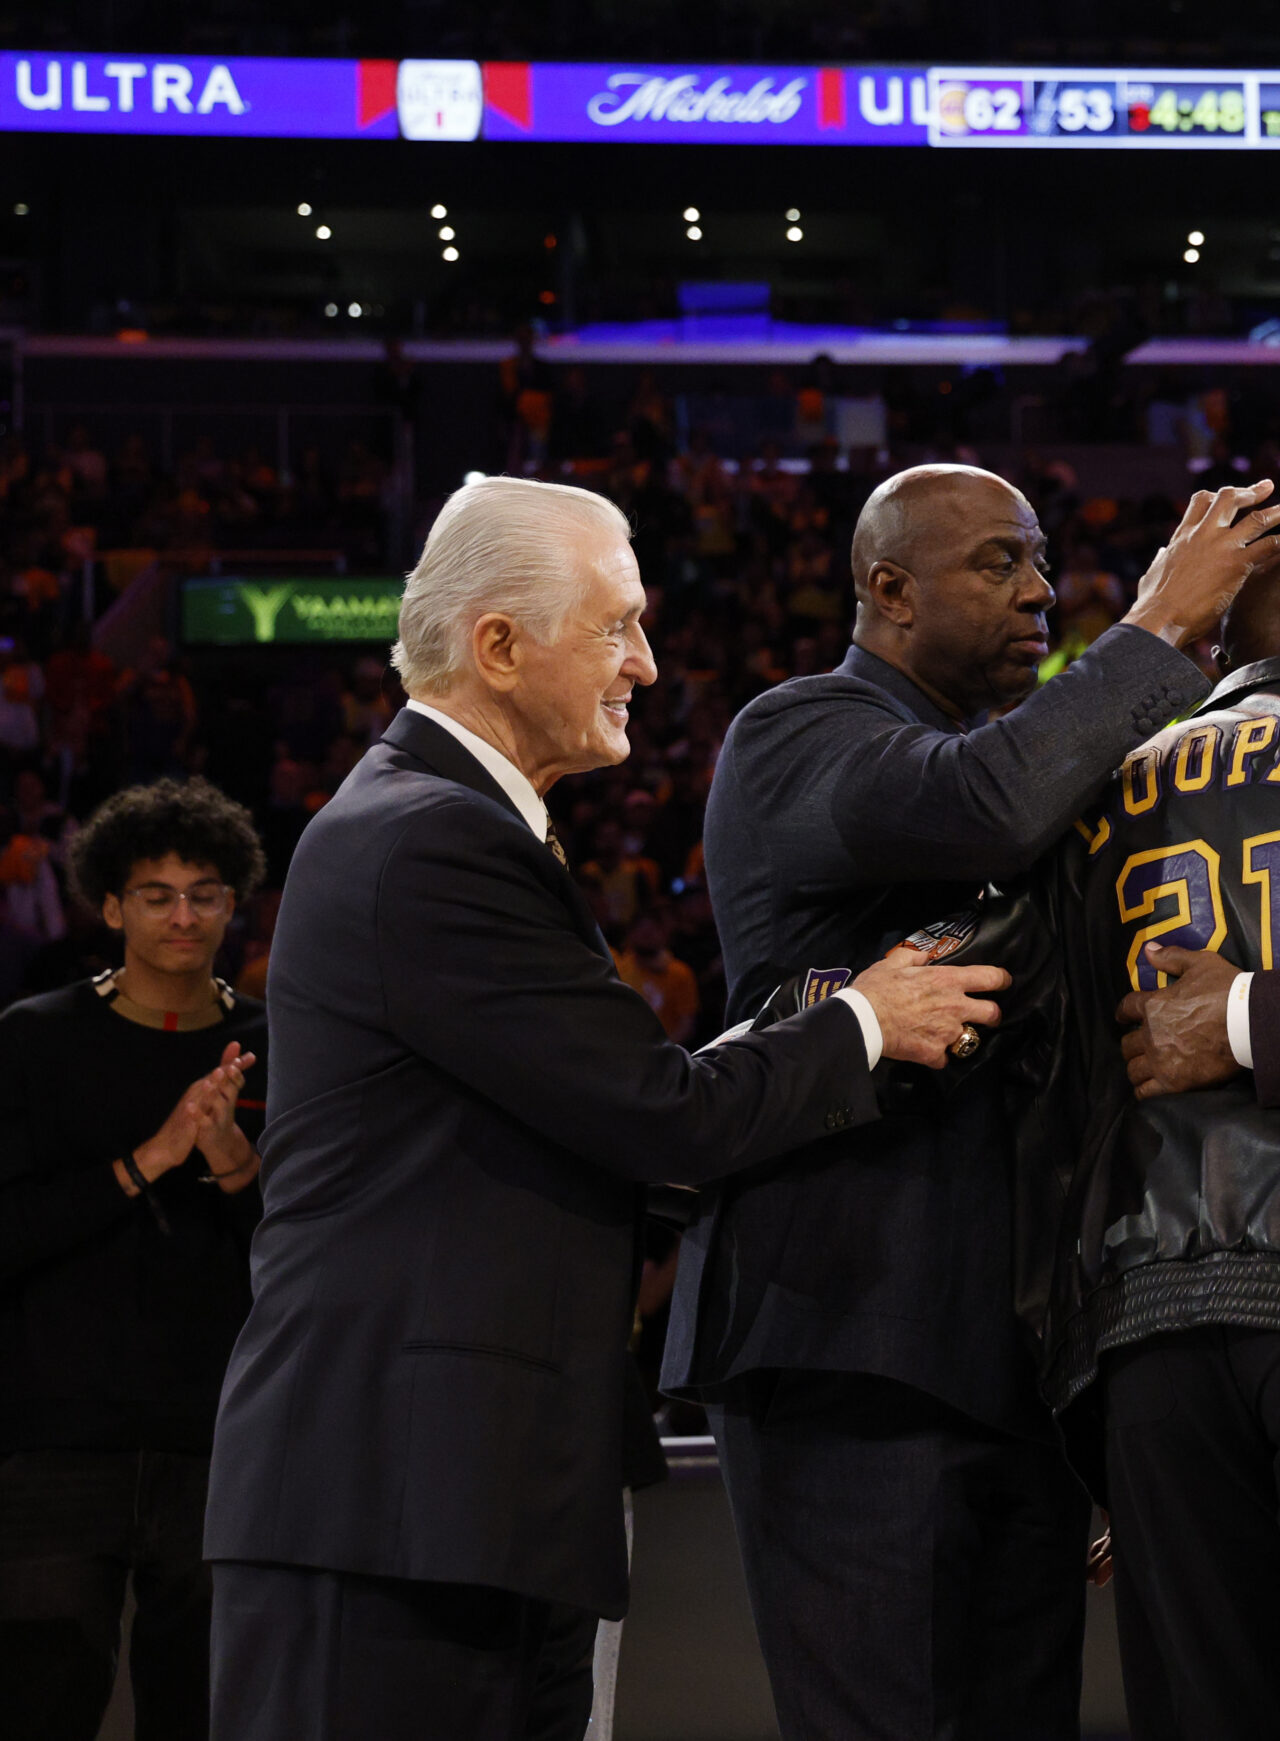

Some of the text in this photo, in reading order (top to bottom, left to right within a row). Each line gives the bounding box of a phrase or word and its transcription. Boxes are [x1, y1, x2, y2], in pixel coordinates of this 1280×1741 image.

[16, 60, 245, 115] ULTRA
[586, 73, 807, 126] Michelob
[964, 88, 1022, 130] 62
[1056, 88, 1114, 131] 53
[1149, 89, 1245, 131] 4:48
